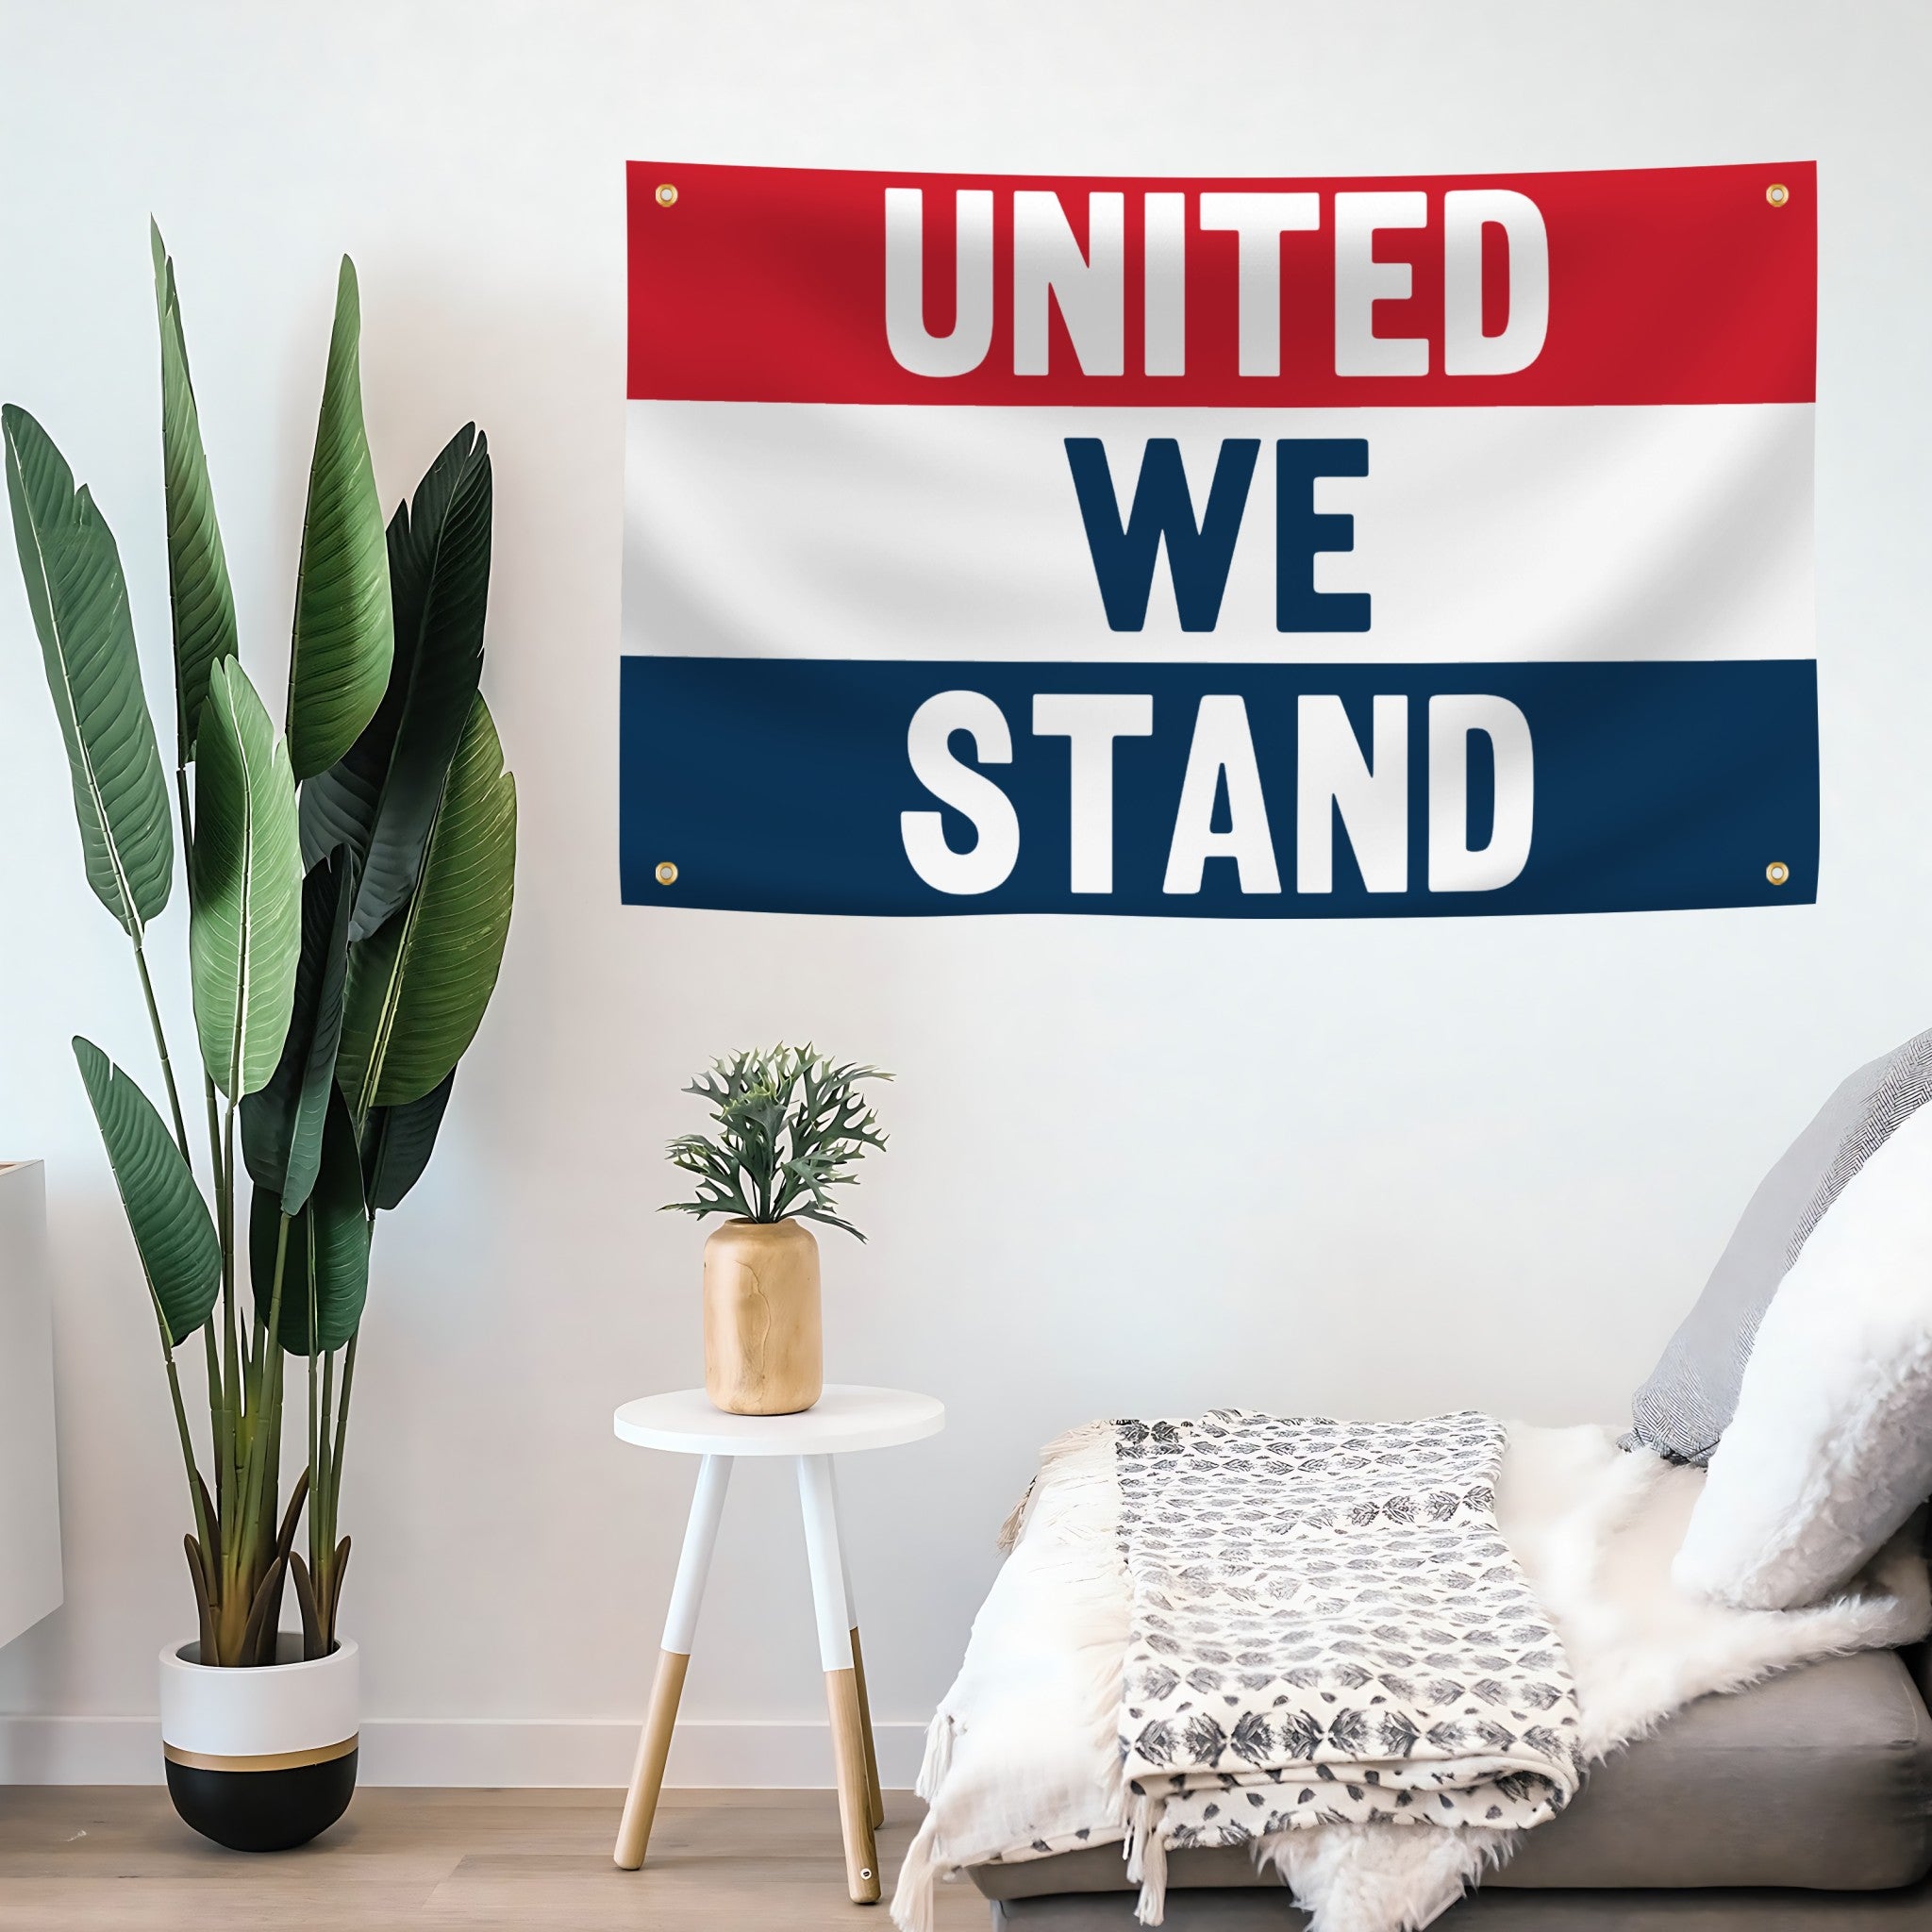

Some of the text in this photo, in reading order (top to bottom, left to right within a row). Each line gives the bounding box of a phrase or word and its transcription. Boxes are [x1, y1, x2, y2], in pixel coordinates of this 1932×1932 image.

[885, 188, 1549, 377] UNITED
[1065, 439, 1371, 632] WE
[901, 691, 1534, 895] STAND
